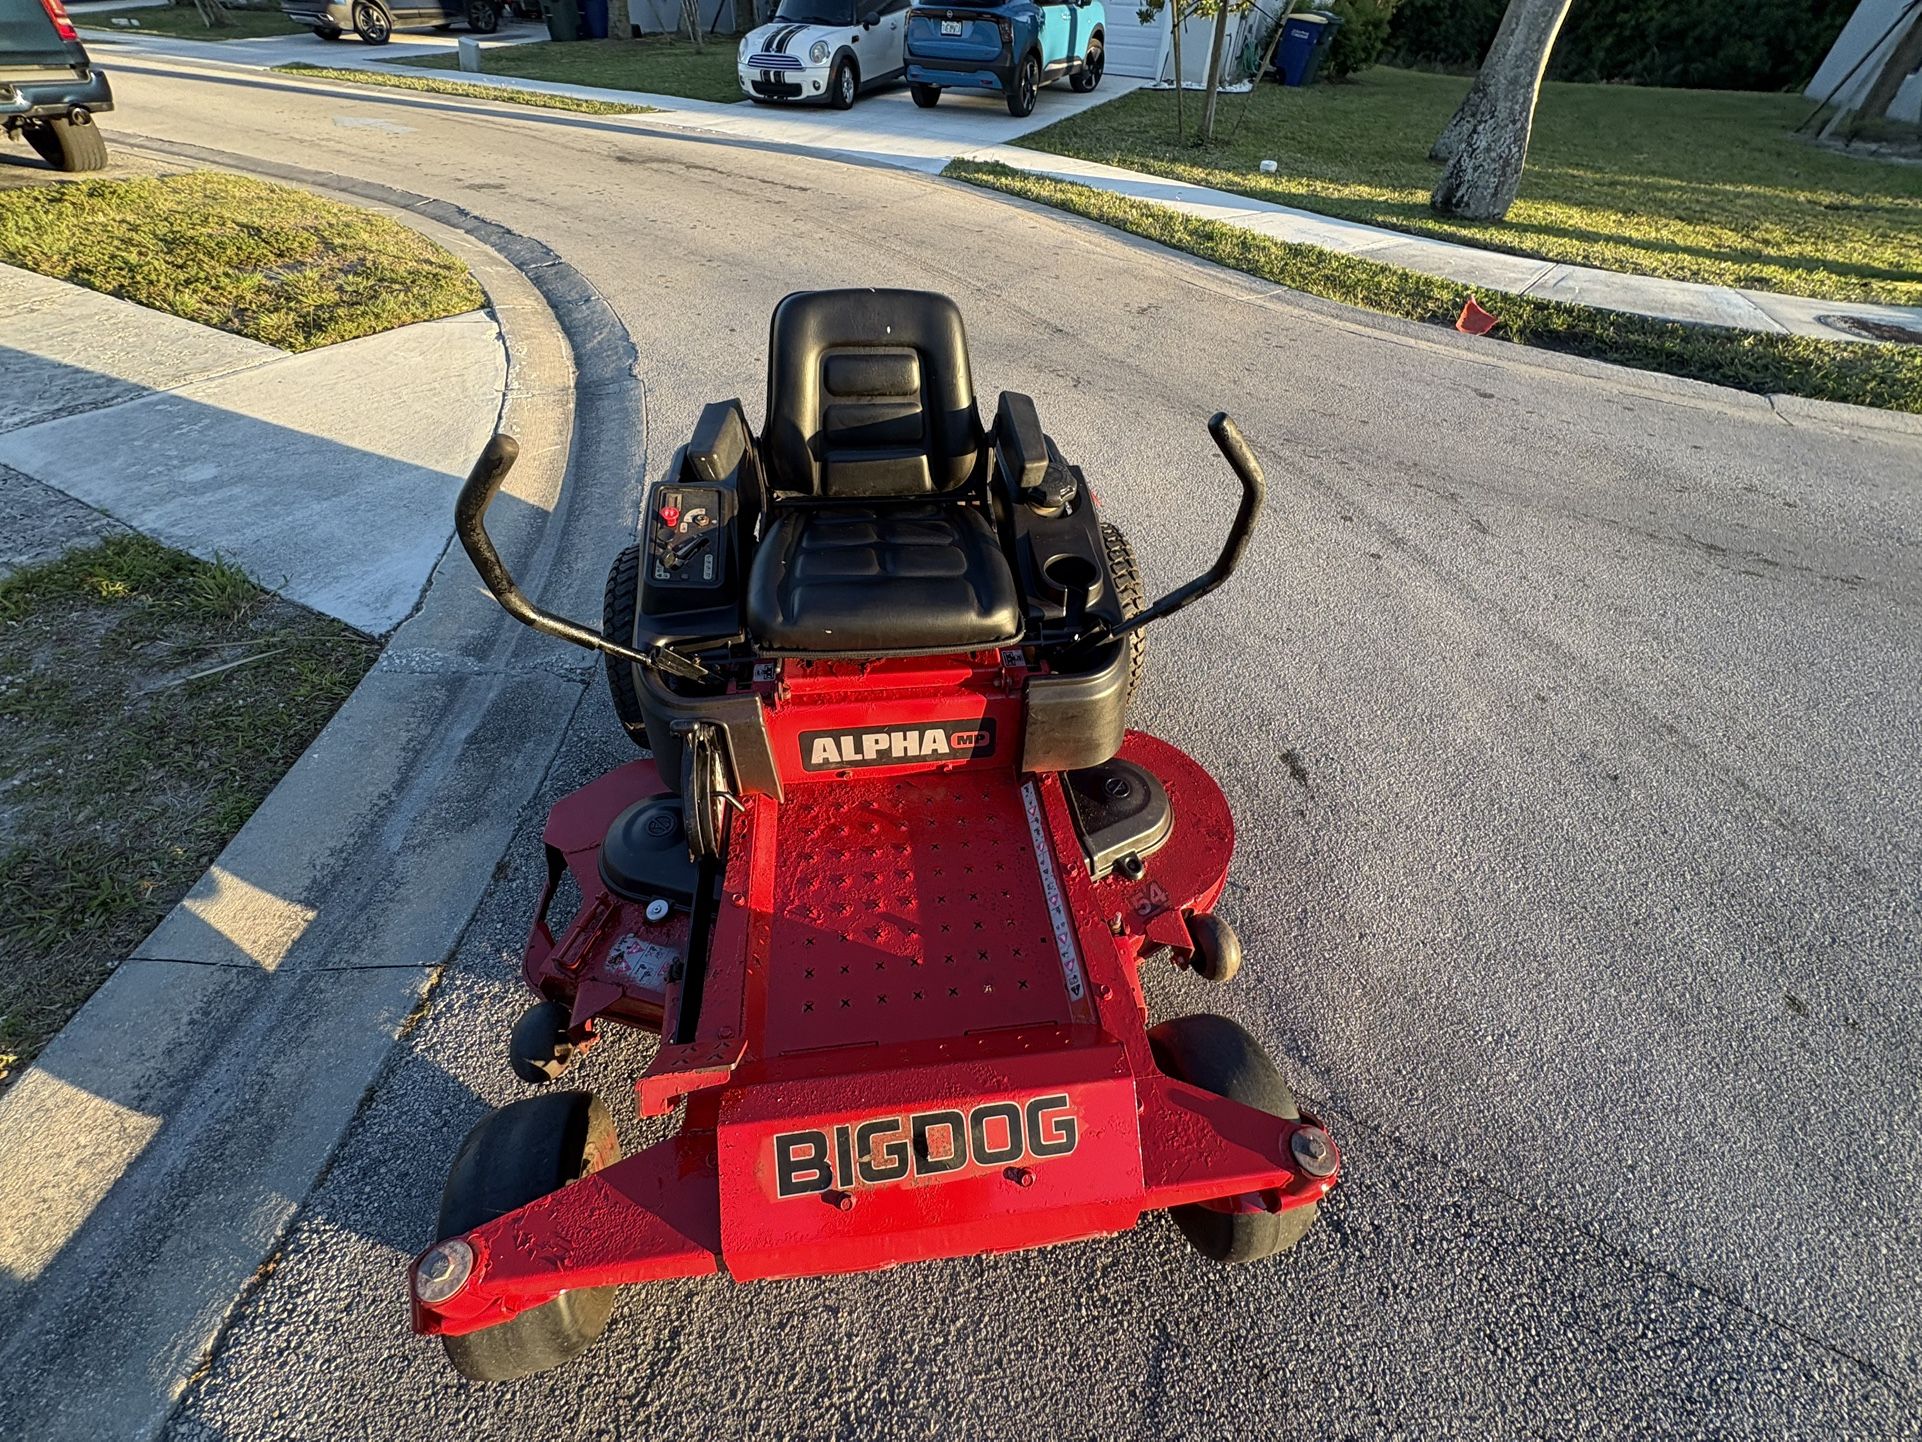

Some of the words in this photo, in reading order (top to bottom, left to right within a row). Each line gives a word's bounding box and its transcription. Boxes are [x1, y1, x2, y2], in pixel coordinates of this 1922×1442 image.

[811, 728, 950, 764] ALPHA
[956, 733, 986, 746] MP
[1131, 881, 1168, 915] 54
[773, 1092, 1079, 1199] BIGDOG
